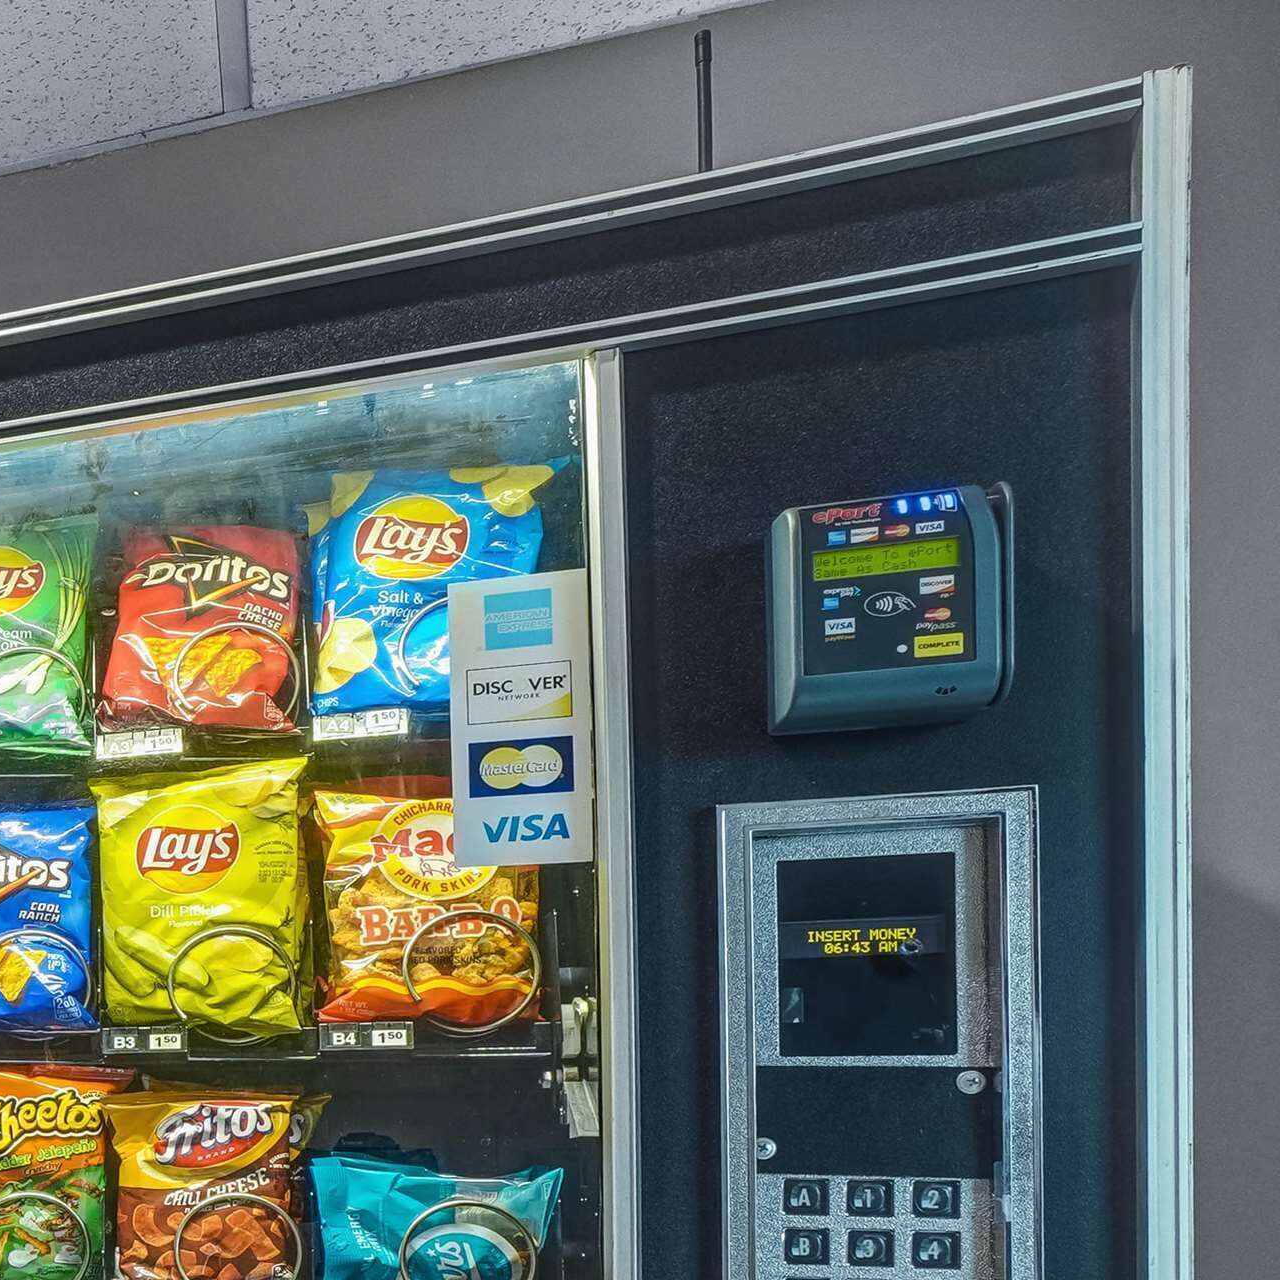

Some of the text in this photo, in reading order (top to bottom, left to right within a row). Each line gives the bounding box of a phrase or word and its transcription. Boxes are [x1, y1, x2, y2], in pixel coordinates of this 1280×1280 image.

[360, 514, 464, 554] Lay's
[918, 522, 942, 532] VISA
[815, 543, 953, 567] Welcome To ePort
[815, 559, 917, 578] Same As Cash
[142, 558, 290, 598] Doritos
[378, 590, 424, 604] Salt &
[243, 602, 284, 620] NACHO
[484, 607, 549, 624] AMERICAN
[238, 612, 283, 631] CHEESE
[498, 621, 553, 634] EXPRESS
[828, 621, 854, 630] VISA
[918, 639, 960, 650] COMPLETE
[472, 674, 566, 696] DISCVER
[498, 692, 541, 703] NETWORK
[478, 756, 559, 776] MasterCard
[482, 813, 570, 843] VISA
[143, 828, 234, 873] Lay's
[394, 868, 431, 893] PORK
[19, 910, 60, 923] RANCH
[29, 902, 60, 914] COOL
[150, 905, 174, 918] Dill
[807, 928, 916, 943] INSERT MONEY
[824, 941, 899, 954] 06:43 AM
[333, 1032, 355, 1046] B4
[155, 1101, 274, 1161] Fritos
[198, 1146, 235, 1162] BRAND
[798, 1189, 940, 1208] A 1 2
[863, 1239, 874, 1257] 3
